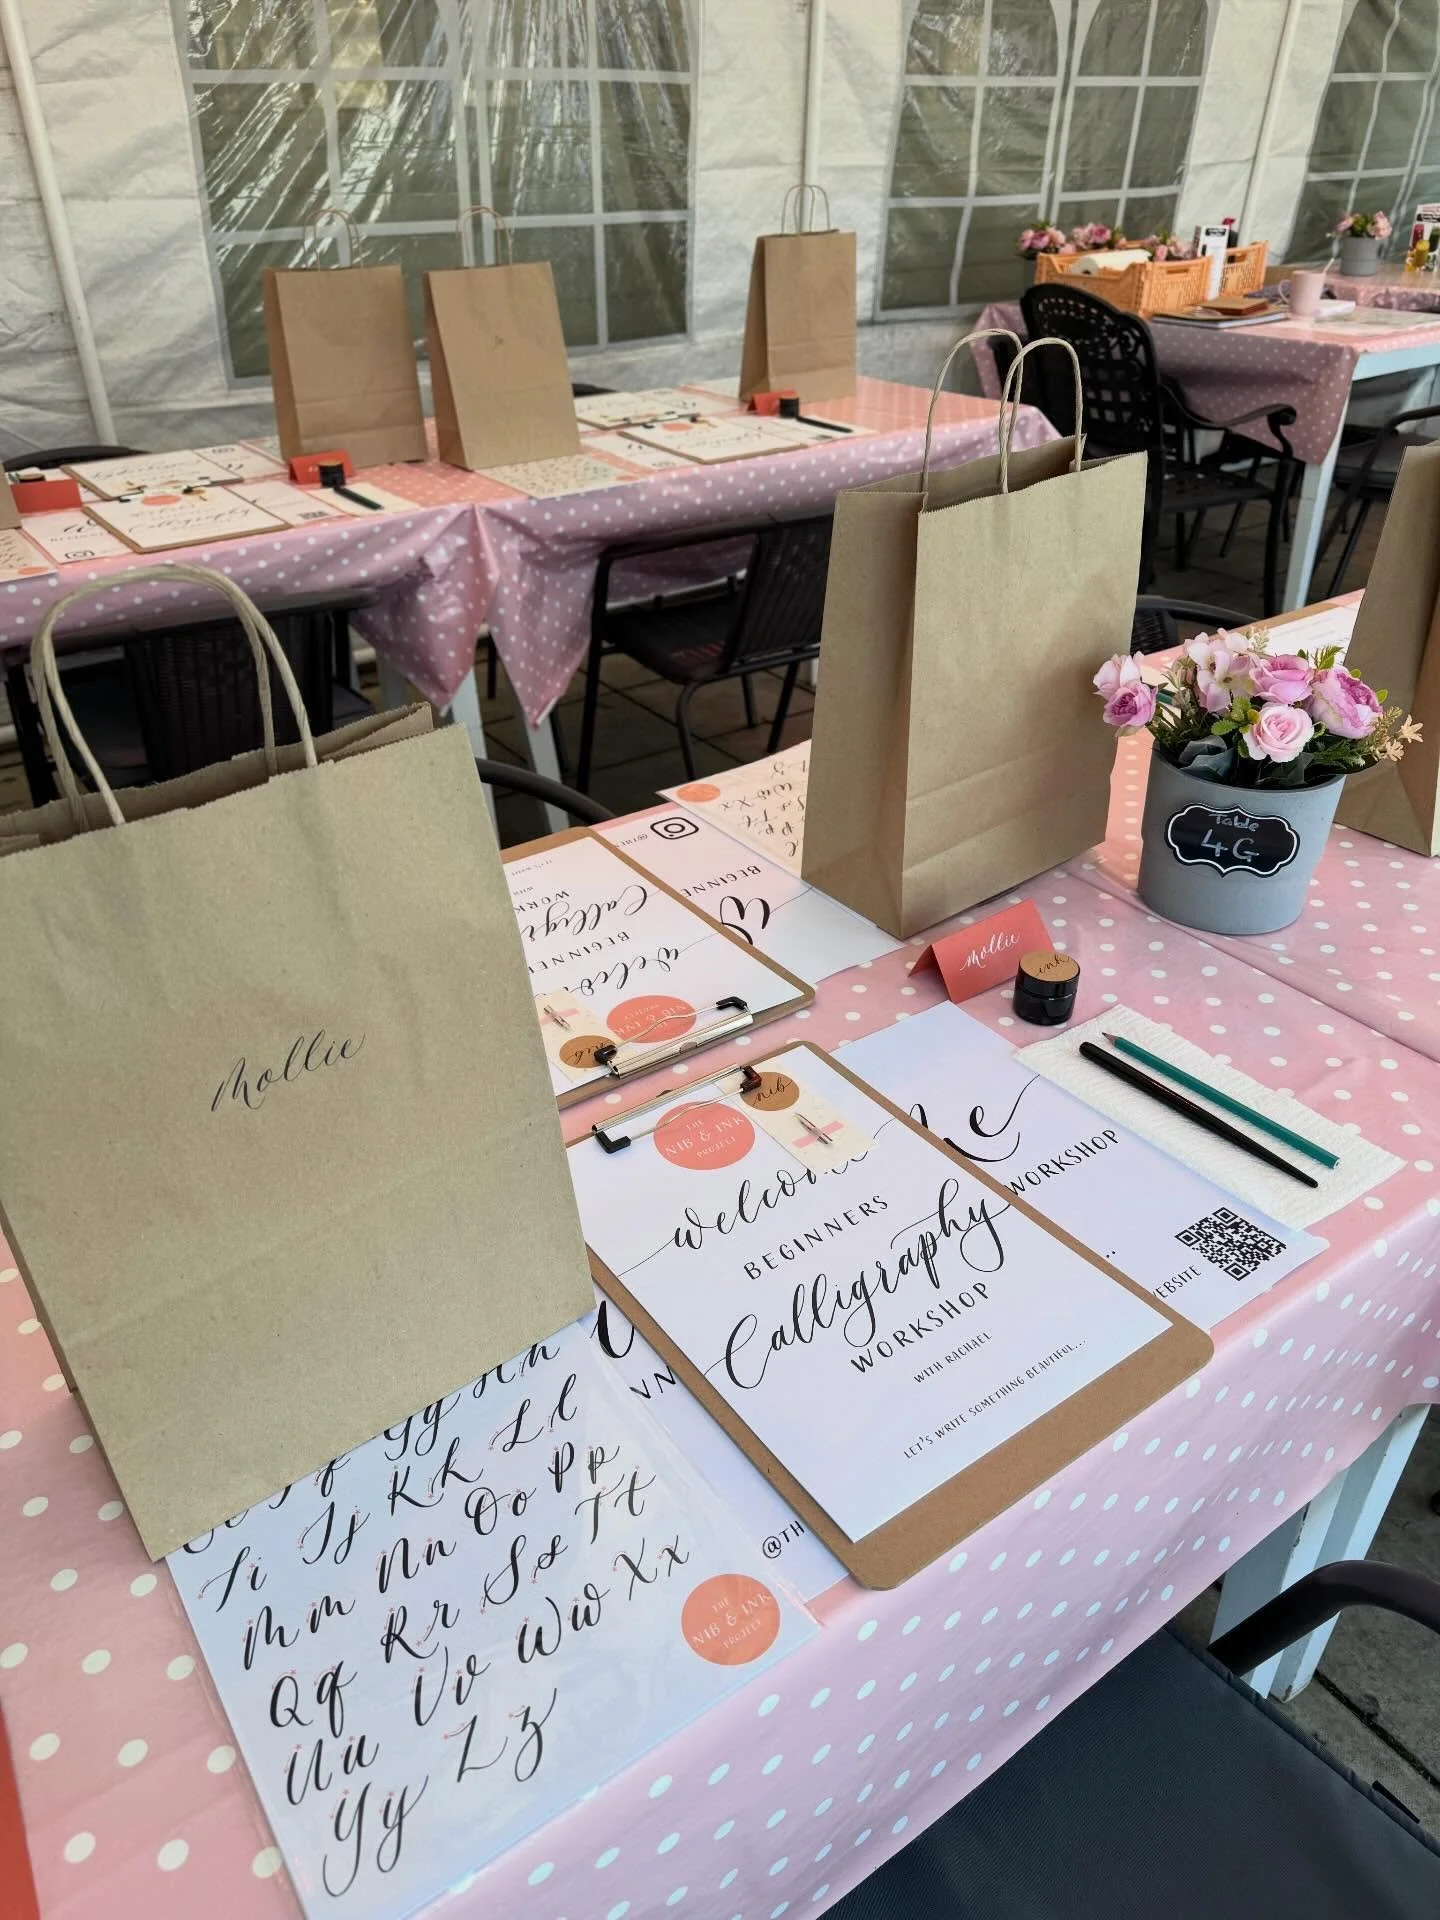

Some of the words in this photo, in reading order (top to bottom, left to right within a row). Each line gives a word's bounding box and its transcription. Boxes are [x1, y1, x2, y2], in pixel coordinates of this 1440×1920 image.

[1201, 828, 1260, 862] 4G
[1208, 813, 1259, 832] Table
[211, 1029, 366, 1113] Mollie
[664, 1136, 694, 1155] NIB
[715, 1116, 745, 1133] INK
[1004, 1130, 1118, 1196] WORKSHOP
[743, 1194, 889, 1281] BEGINNERS
[702, 1178, 1011, 1389] Calligraphy
[1153, 1265, 1202, 1299] EBSITE
[850, 1282, 990, 1374] WORKSHOP
[913, 1360, 945, 1384] WITH
[944, 1332, 993, 1365] RACHAEL
[904, 1435, 934, 1460] LET'S
[934, 1413, 968, 1440] WRITE
[968, 1376, 1026, 1417] SOMETHING
[692, 1622, 721, 1648] NIB
